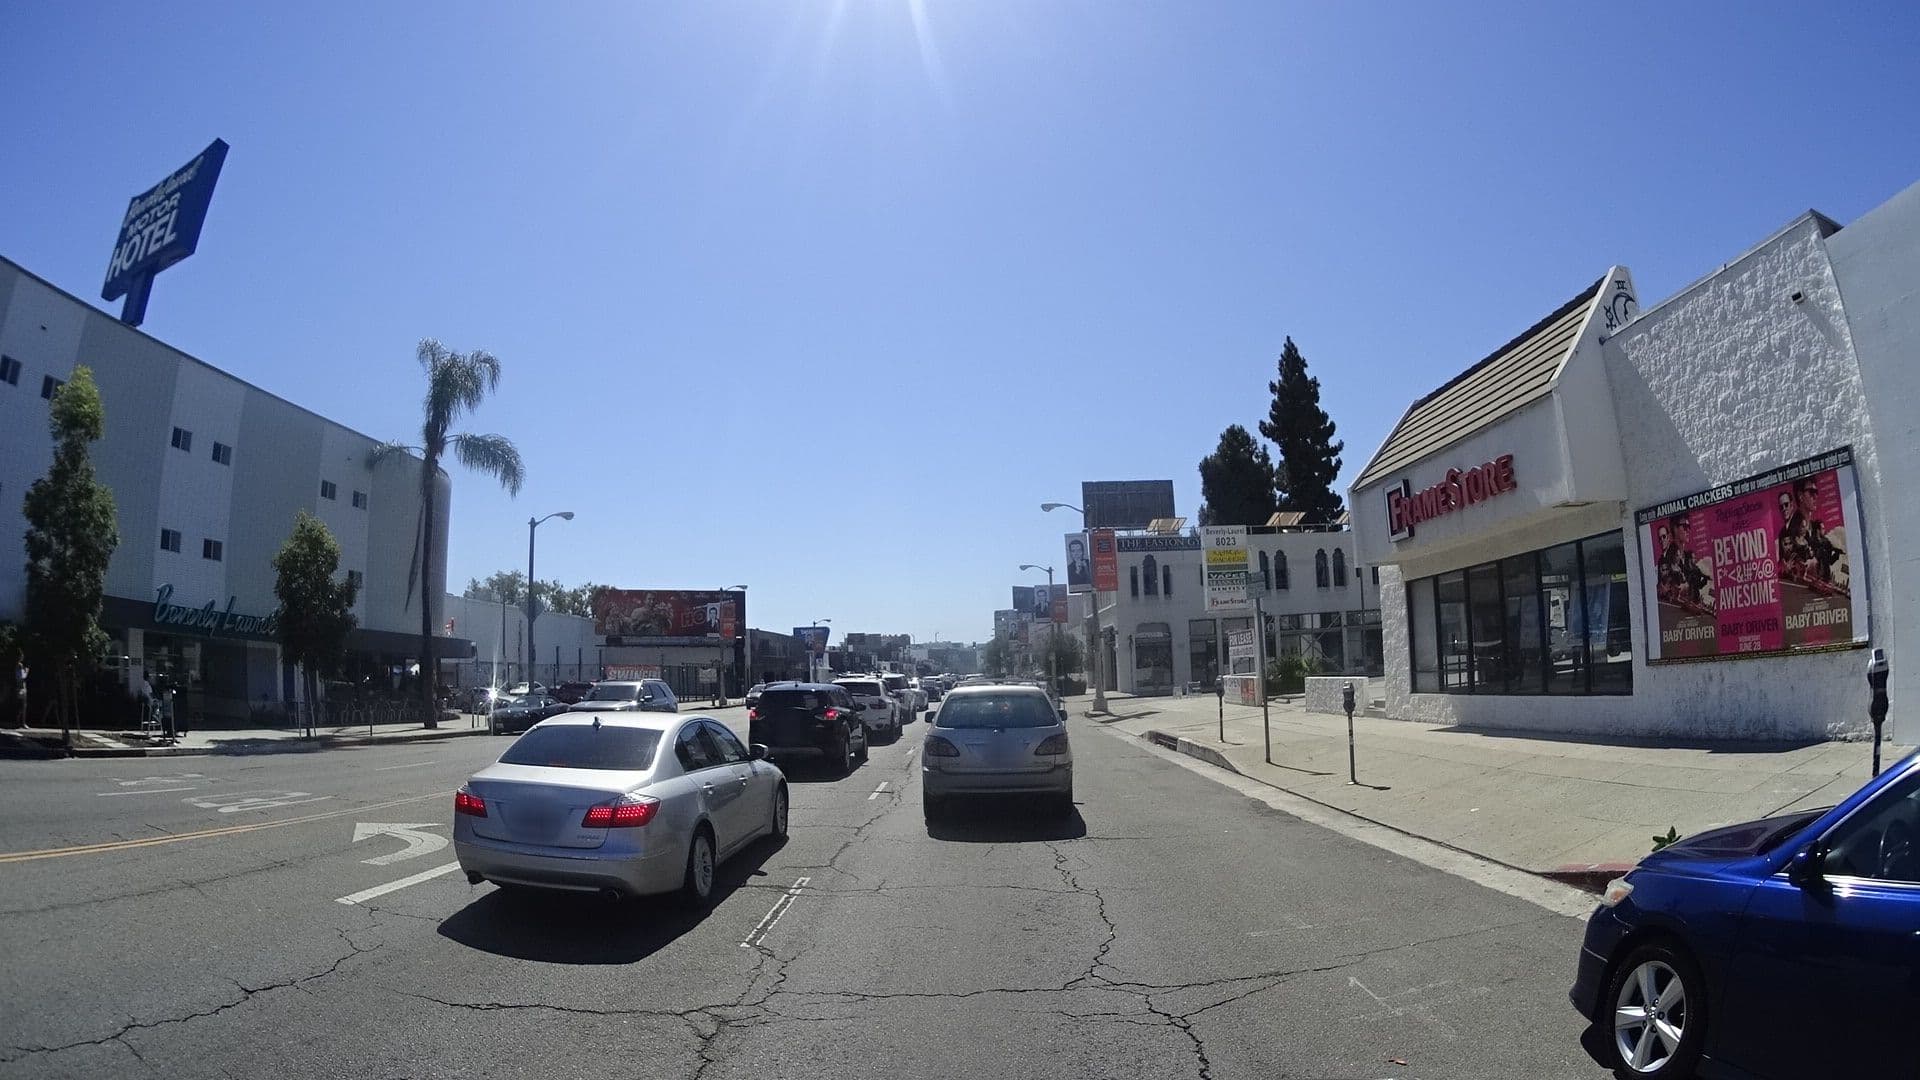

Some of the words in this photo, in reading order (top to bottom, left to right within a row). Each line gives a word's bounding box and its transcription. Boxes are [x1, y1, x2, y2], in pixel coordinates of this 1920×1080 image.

[126, 192, 181, 240] MOTOR
[106, 208, 177, 282] HOTEL
[1656, 500, 1687, 518] ANIMAL
[1687, 485, 1733, 508] CRACKERS
[1121, 539, 1139, 548] THE
[1215, 537, 1236, 546] 8023
[154, 583, 220, 638] Beverly
[1785, 613, 1811, 629] BABY
[1813, 608, 1848, 626] DRIVER
[1663, 629, 1683, 642] BABY
[1685, 626, 1715, 640] DRIVER
[1722, 622, 1744, 636] BABY
[1746, 618, 1778, 633] DRIVER
[1739, 642, 1754, 651] JUNE
